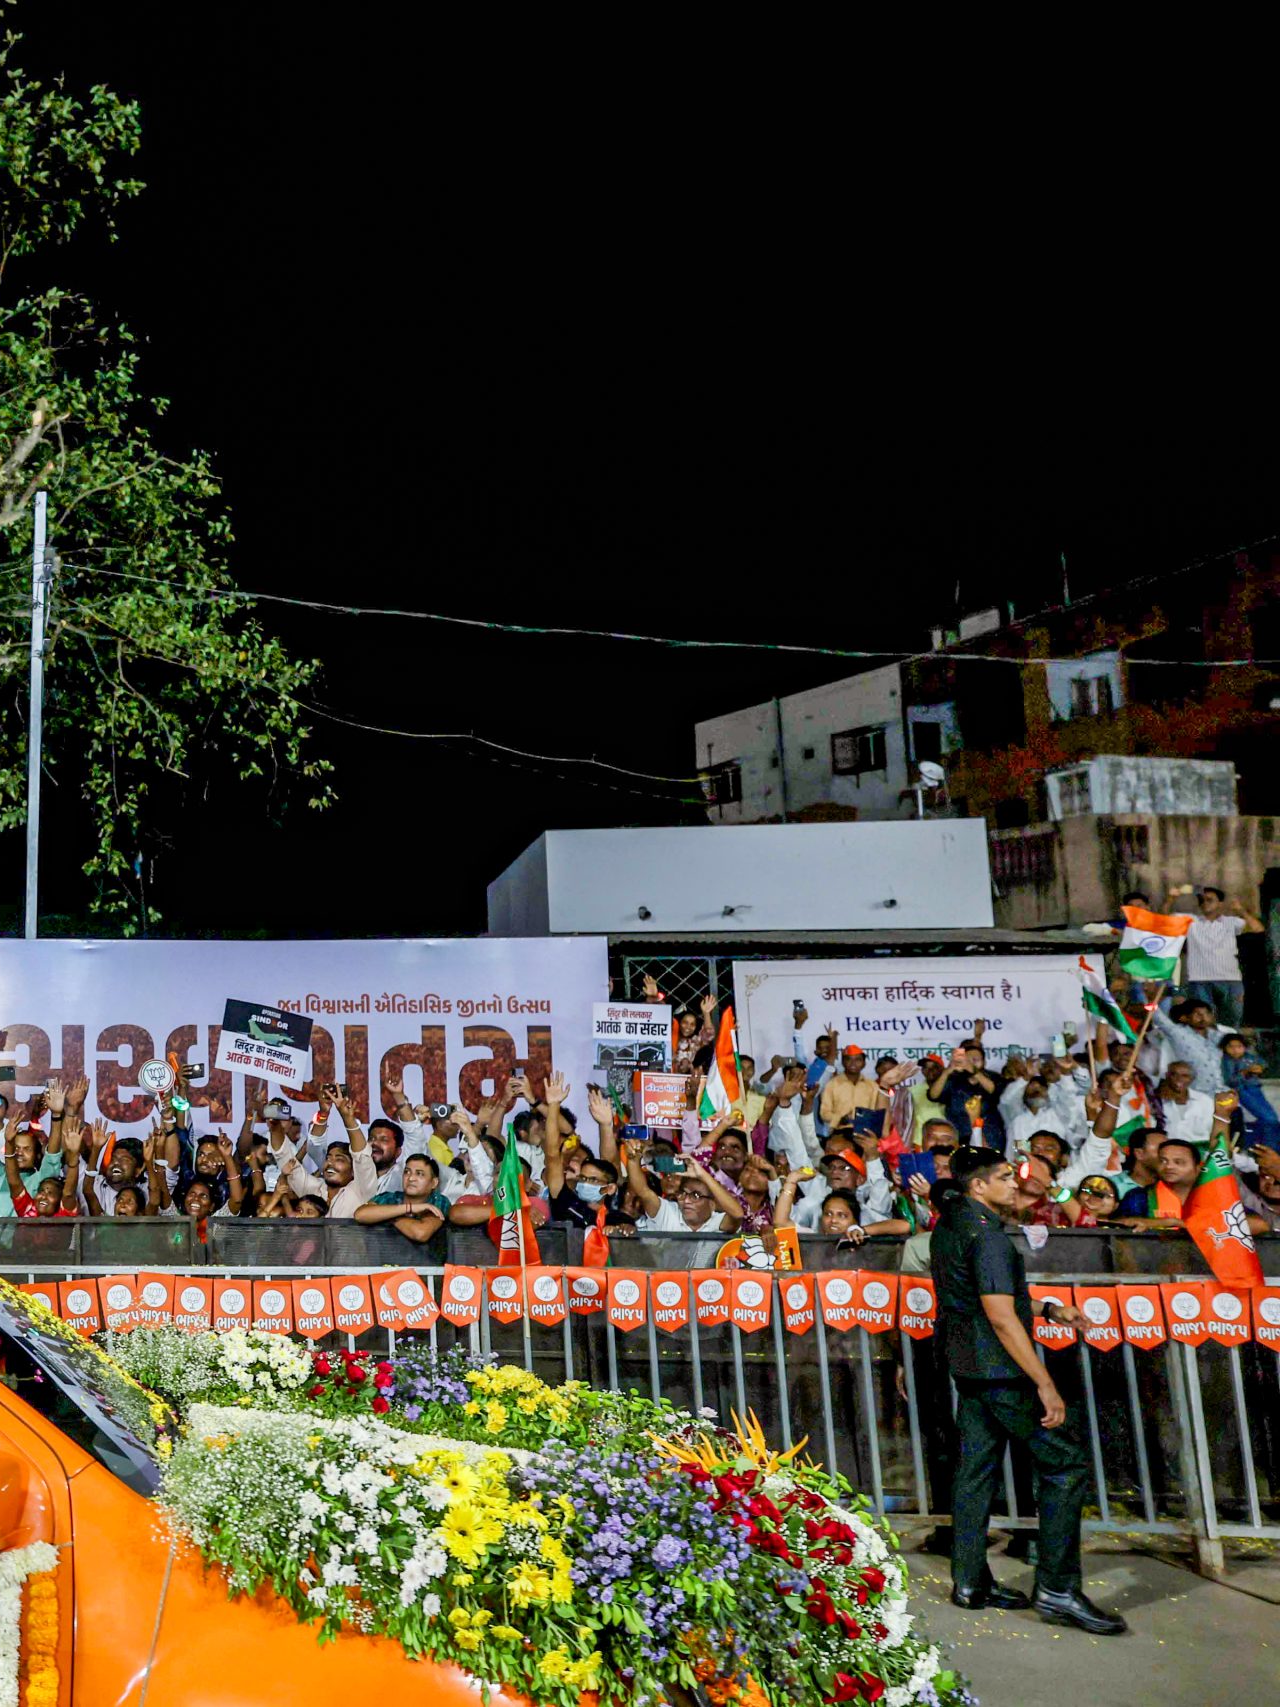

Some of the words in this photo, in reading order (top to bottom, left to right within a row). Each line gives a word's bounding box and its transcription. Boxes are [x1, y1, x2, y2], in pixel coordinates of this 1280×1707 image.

[822, 987, 878, 1001] आपका
[885, 981, 935, 1002] हार्दिक
[940, 986, 995, 1000] स्वागत
[278, 999, 301, 1013] જન
[305, 993, 370, 1014] વિશ્વાસની
[374, 992, 452, 1014] ઐતિહાસિક
[456, 994, 503, 1017] જીતનો
[507, 995, 552, 1014] ઉત્સવ
[596, 1018, 621, 1033] आतंक
[625, 1022, 638, 1035] का
[640, 1020, 668, 1036] संहार
[846, 1016, 910, 1035] Hearty
[234, 1038, 255, 1054] सिंदूर
[255, 1043, 267, 1055] का
[226, 1051, 252, 1065] आतंक
[254, 1056, 266, 1069] का
[444, 1302, 477, 1318] ભાજપ
[488, 1300, 521, 1315] ભાજપ
[531, 1303, 565, 1317] ભાજપ
[570, 1297, 603, 1309] ભાજપ
[338, 1312, 371, 1326] ભાજપ
[380, 1309, 402, 1324] ભાજ
[406, 1302, 438, 1325] ભાજપ
[611, 1308, 644, 1322] ભાજપ
[655, 1309, 686, 1322] ભાજપ
[698, 1304, 728, 1319] ભાજપ
[733, 1308, 767, 1323] ભાજપ
[787, 1310, 814, 1327] ભાજપ
[857, 1310, 892, 1327] ભાજપ
[217, 1317, 249, 1330] ભાજપ
[257, 1318, 290, 1330] ભાજપ
[298, 1316, 331, 1330] ભાજપ
[1207, 1321, 1248, 1338] ભાજપ
[1036, 1325, 1073, 1340] ભાજપ
[1086, 1326, 1119, 1341] ભાજપ
[1127, 1325, 1162, 1339] ભાજપ
